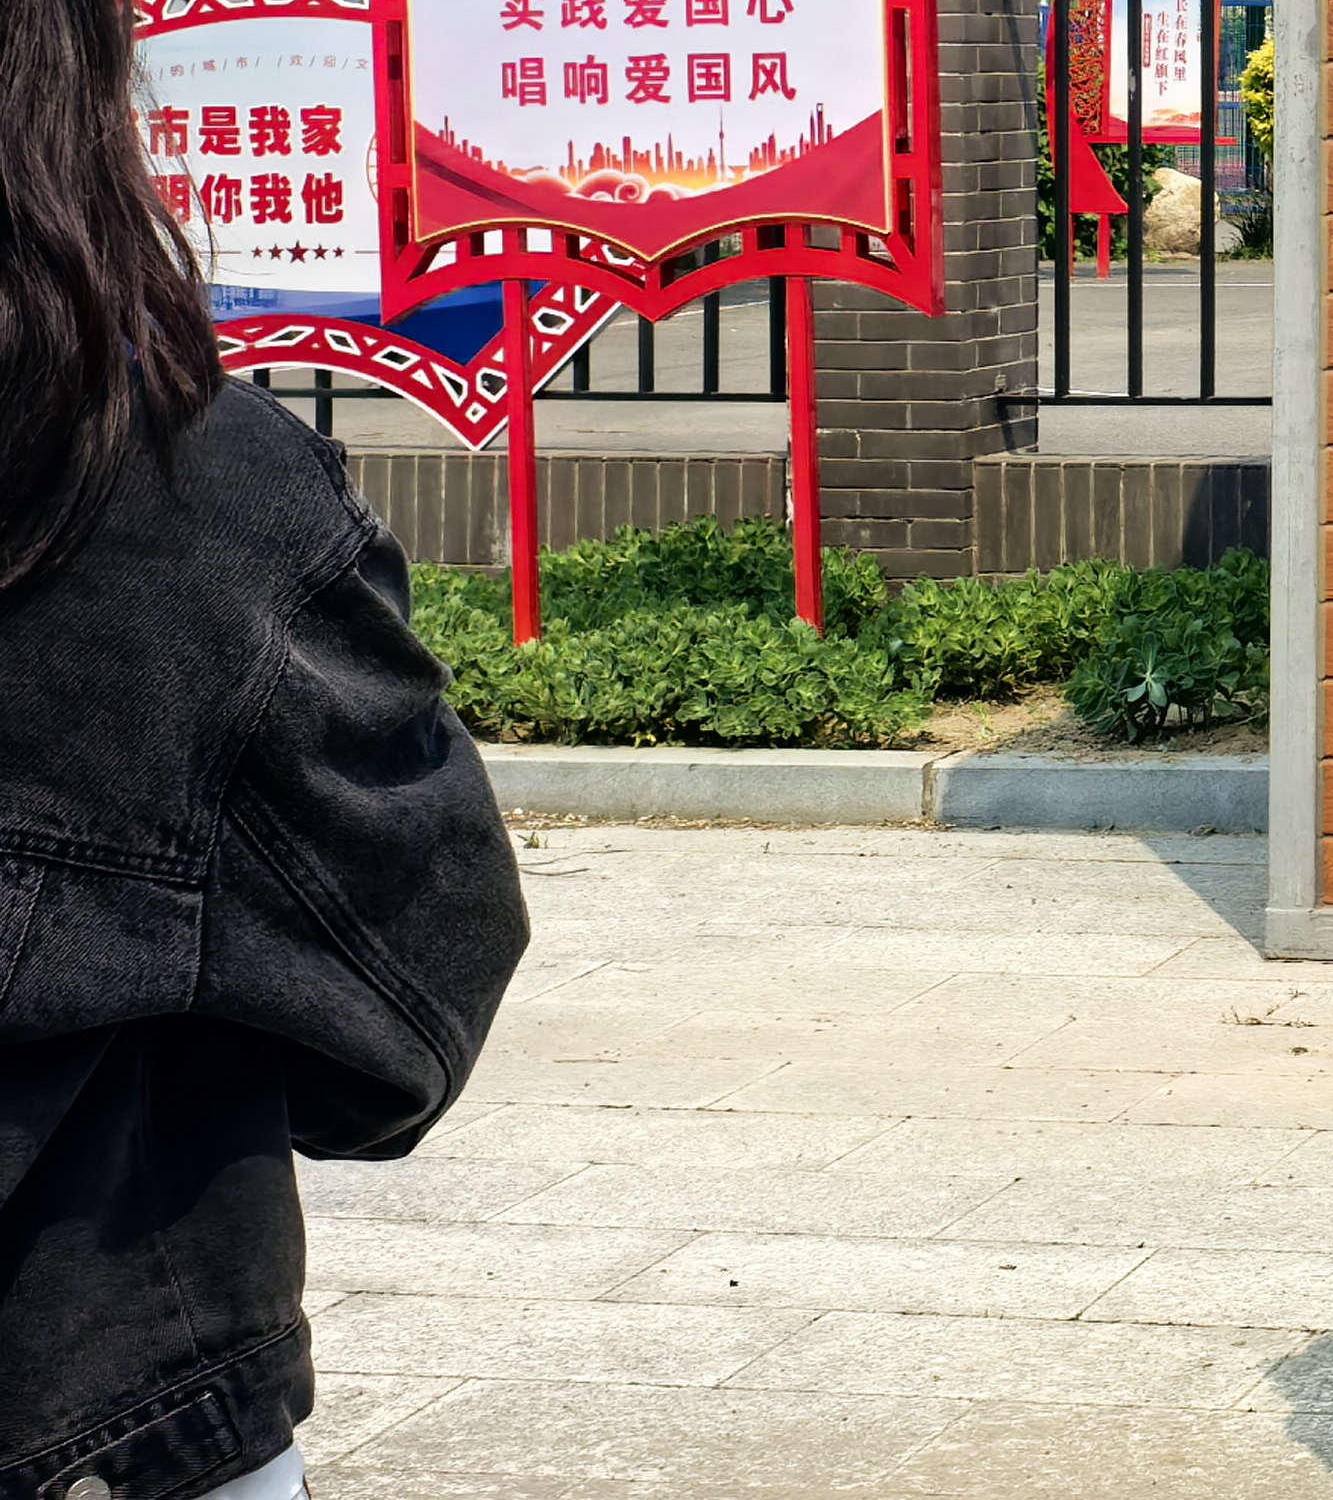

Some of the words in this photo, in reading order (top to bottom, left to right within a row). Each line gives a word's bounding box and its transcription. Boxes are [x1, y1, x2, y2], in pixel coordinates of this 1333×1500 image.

[501, 52, 797, 106] 唱响爱国风
[132, 105, 343, 157] 市是我家
